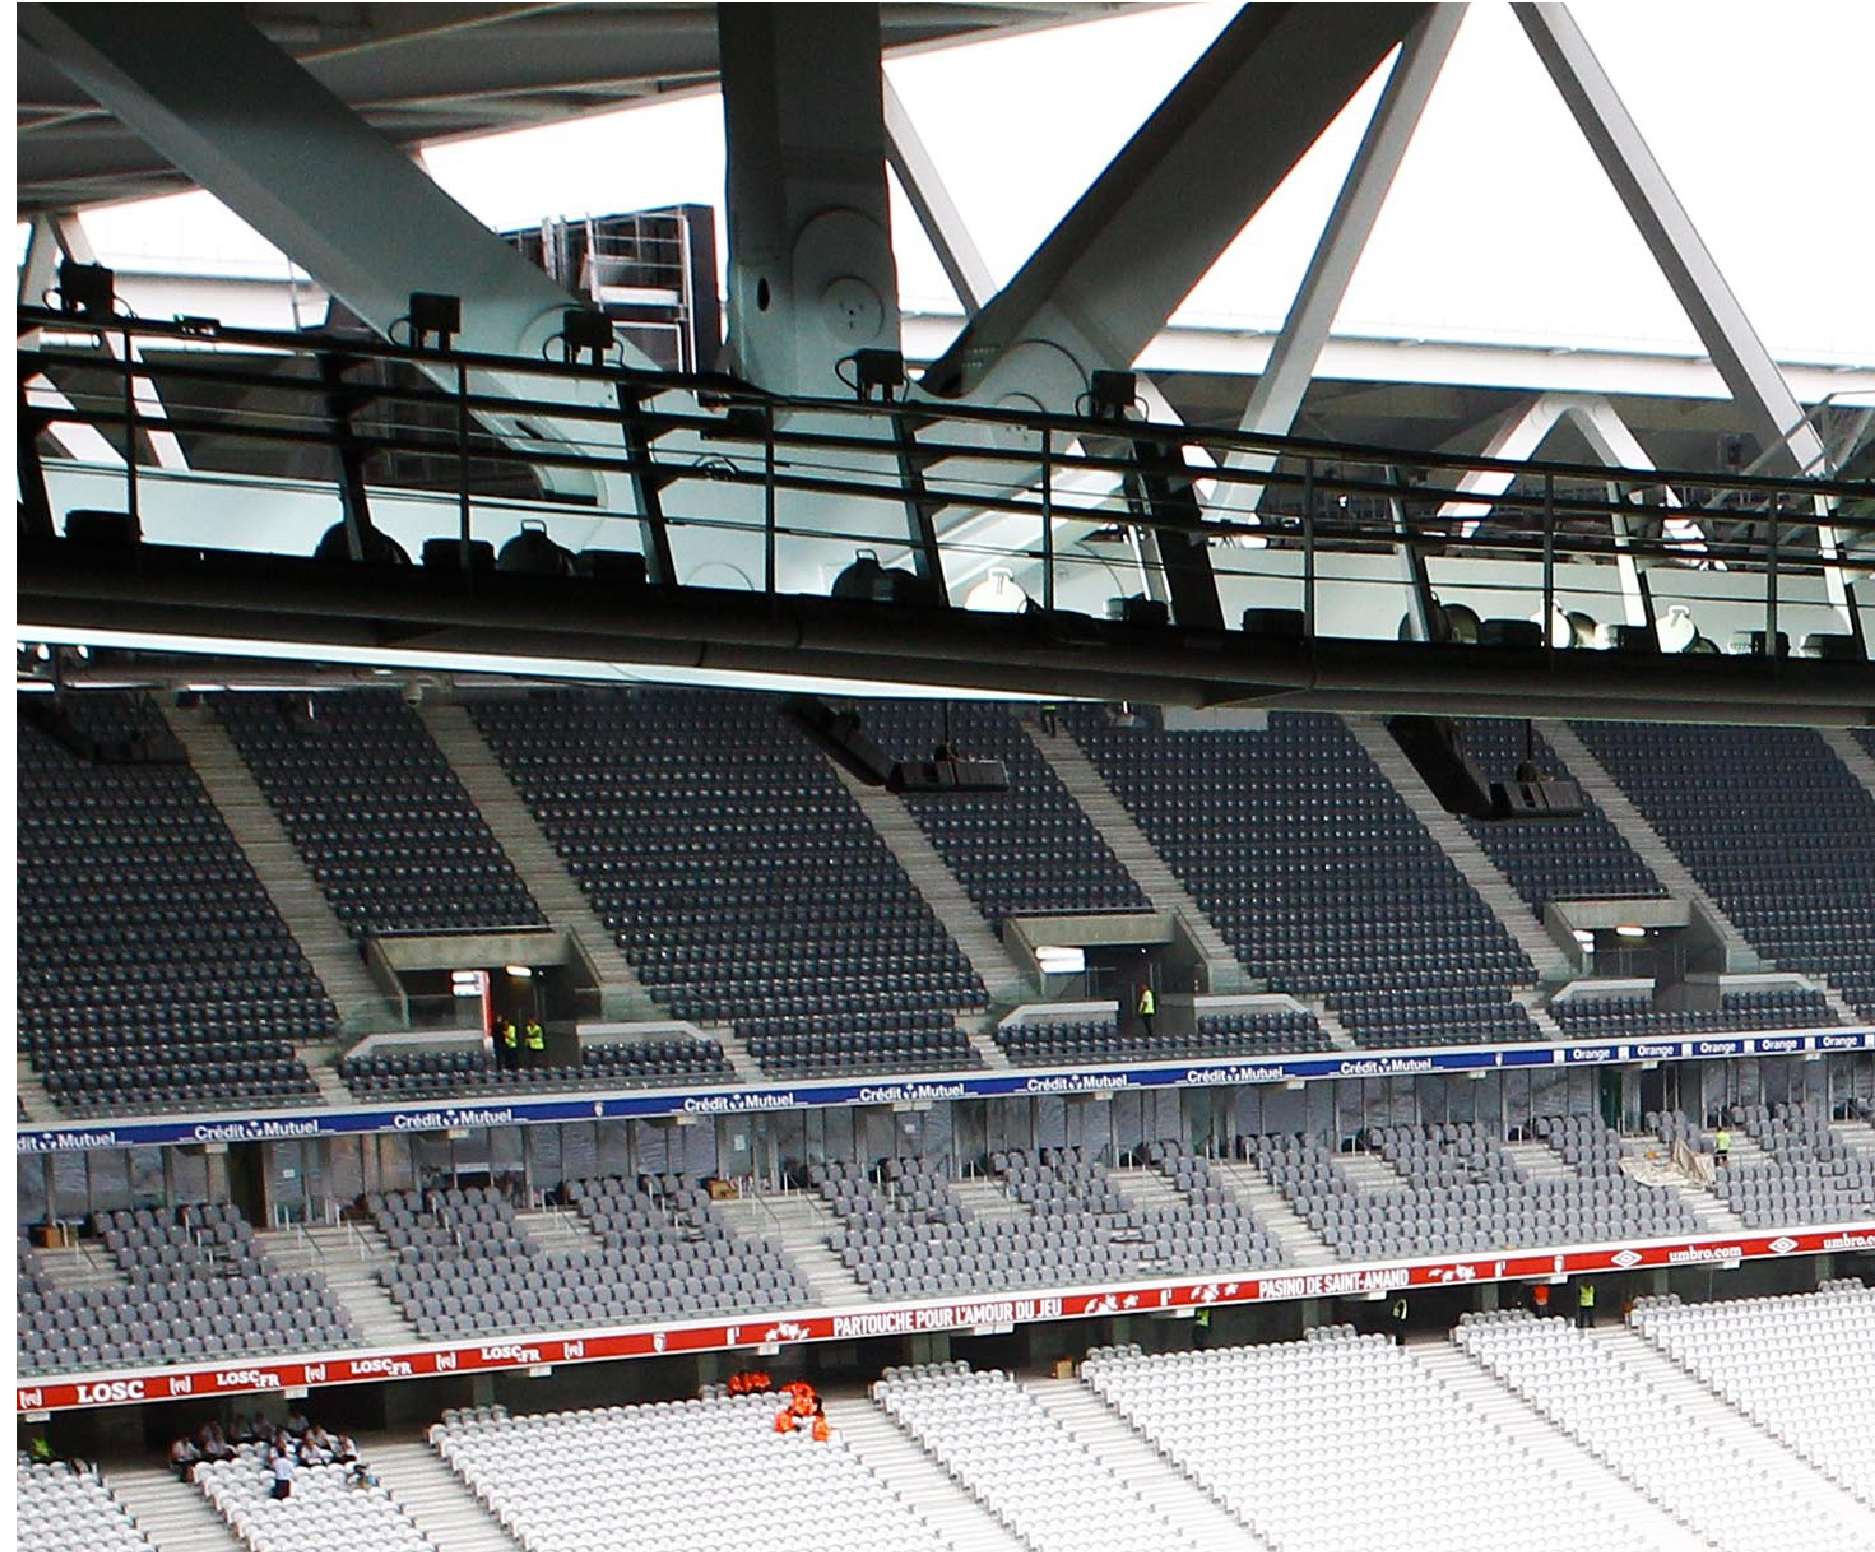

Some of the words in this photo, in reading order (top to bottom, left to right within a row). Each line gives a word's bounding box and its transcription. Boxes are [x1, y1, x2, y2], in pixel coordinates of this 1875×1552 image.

[1637, 1045, 1675, 1057] Orange
[1701, 1043, 1737, 1054] Orange
[1762, 1039, 1798, 1052] Orange
[1823, 1036, 1858, 1049] Orange
[1573, 1049, 1611, 1059] Orange
[1340, 1061, 1378, 1074] Crédit
[1391, 1057, 1432, 1071] Mutuel
[1187, 1069, 1227, 1083] Crédit
[1240, 1066, 1283, 1080] Mutuel
[1027, 1078, 1068, 1092] Crédit
[1084, 1075, 1128, 1089] Mutuel
[859, 1087, 902, 1101] Crédit
[919, 1084, 965, 1098] Mutuel
[684, 1097, 728, 1112] Crédit
[747, 1093, 794, 1108] Mutuel
[394, 1112, 443, 1128] Crédit
[461, 1109, 512, 1125] Mutuel
[195, 1123, 245, 1140] Crédit
[264, 1120, 318, 1135] Mutuel
[57, 1132, 116, 1148] Mutuel
[1669, 1245, 1742, 1262] umbro.com
[1259, 1277, 1303, 1298] PASINO
[1306, 1275, 1323, 1294] DE
[1324, 1268, 1410, 1293] SAINT-AMAND
[833, 1312, 914, 1337] PARTOUCHE
[916, 1307, 953, 1328] POUR
[956, 1302, 1013, 1325] L'AMOUR
[1015, 1300, 1035, 1320] DU
[1038, 1298, 1062, 1317] JEU
[77, 1382, 145, 1404] LOSC
